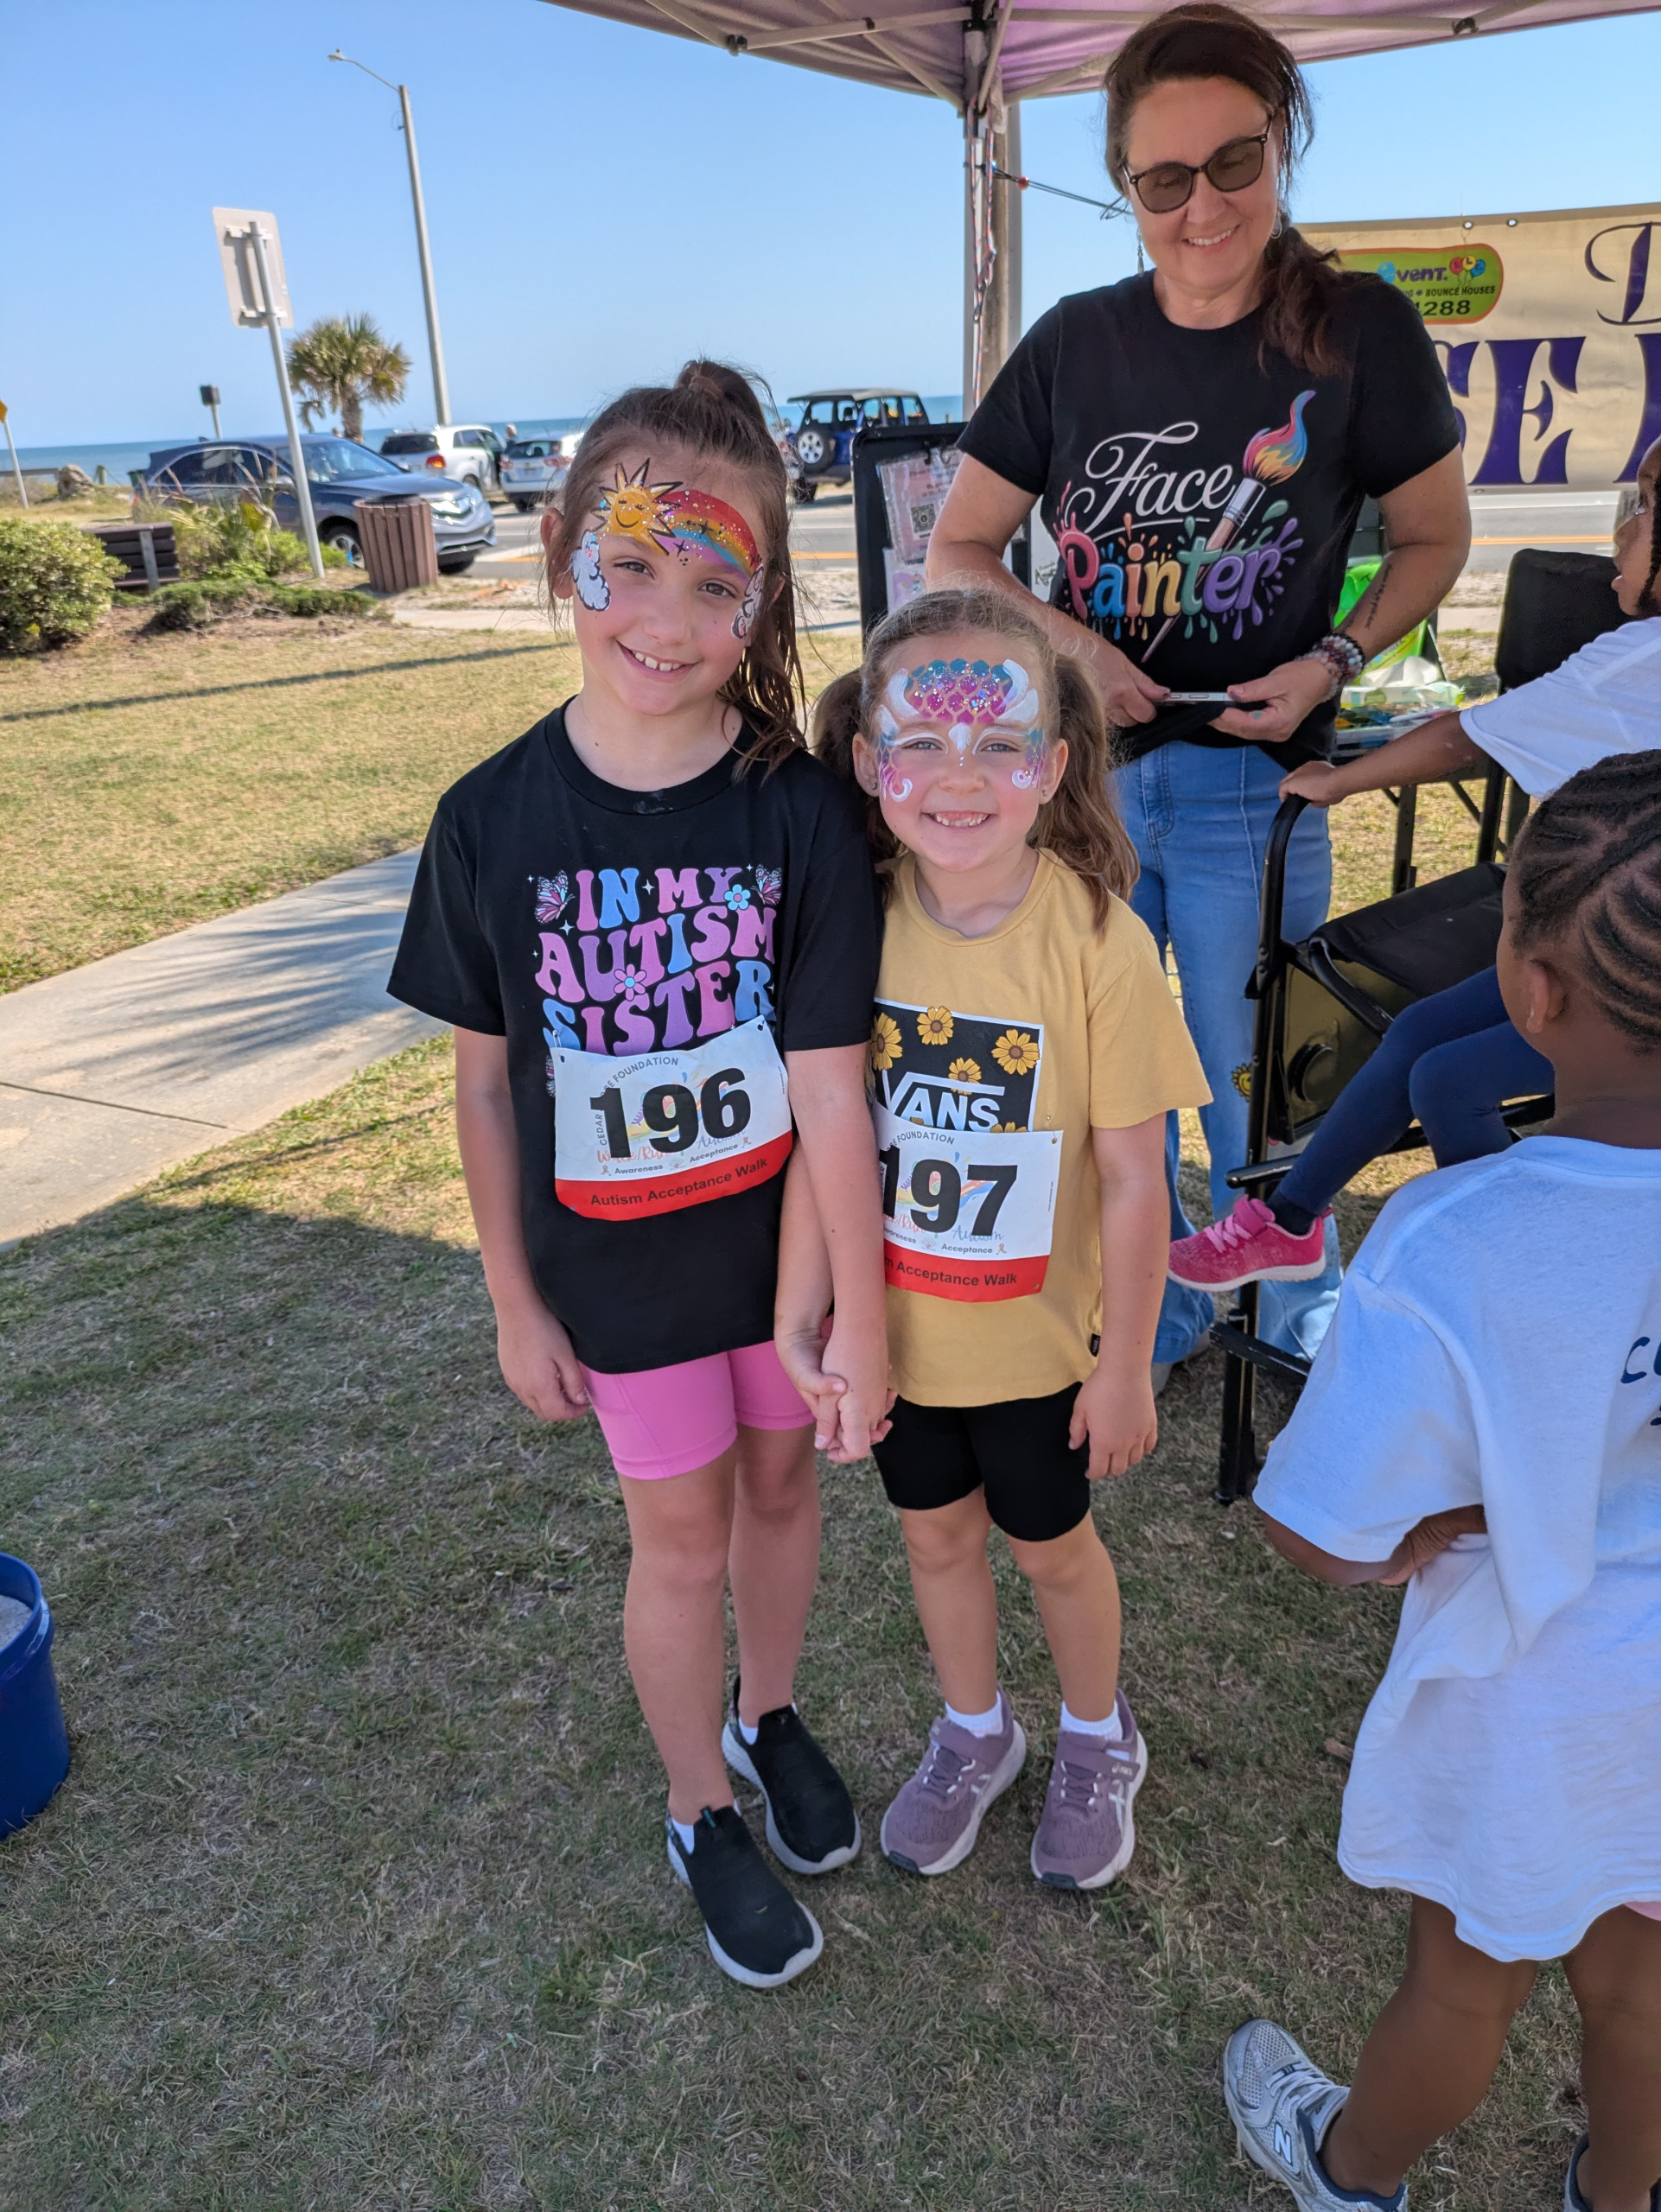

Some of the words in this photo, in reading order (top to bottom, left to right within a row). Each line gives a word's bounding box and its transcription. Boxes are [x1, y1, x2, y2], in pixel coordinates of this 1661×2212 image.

[1425, 287, 1459, 297] BOUNCE
[1461, 285, 1496, 296] HOUSES
[1065, 421, 1237, 533] Face
[1058, 529, 1283, 620] Painter
[576, 868, 640, 931] IN
[654, 867, 743, 913] MY
[535, 905, 777, 1003] AUTISM
[542, 960, 777, 1057] SISTER
[613, 1057, 678, 1083] FOUNDATION
[589, 1067, 752, 1159] 196
[881, 1071, 1005, 1134] VANS
[595, 1114, 608, 1146] CEDAR
[896, 1130, 955, 1145] FOUNDATION
[614, 1165, 664, 1174] Awareness
[690, 1144, 738, 1163] Acceptance
[590, 1195, 643, 1206] Autism
[647, 1173, 732, 1202] Acceptance
[735, 1158, 767, 1178] Walk
[879, 1145, 1018, 1236] 197
[883, 1227, 916, 1244] wareness
[941, 1243, 993, 1255] Acceptance
[896, 1262, 979, 1286] Acceptance
[984, 1274, 1018, 1287] Walk
